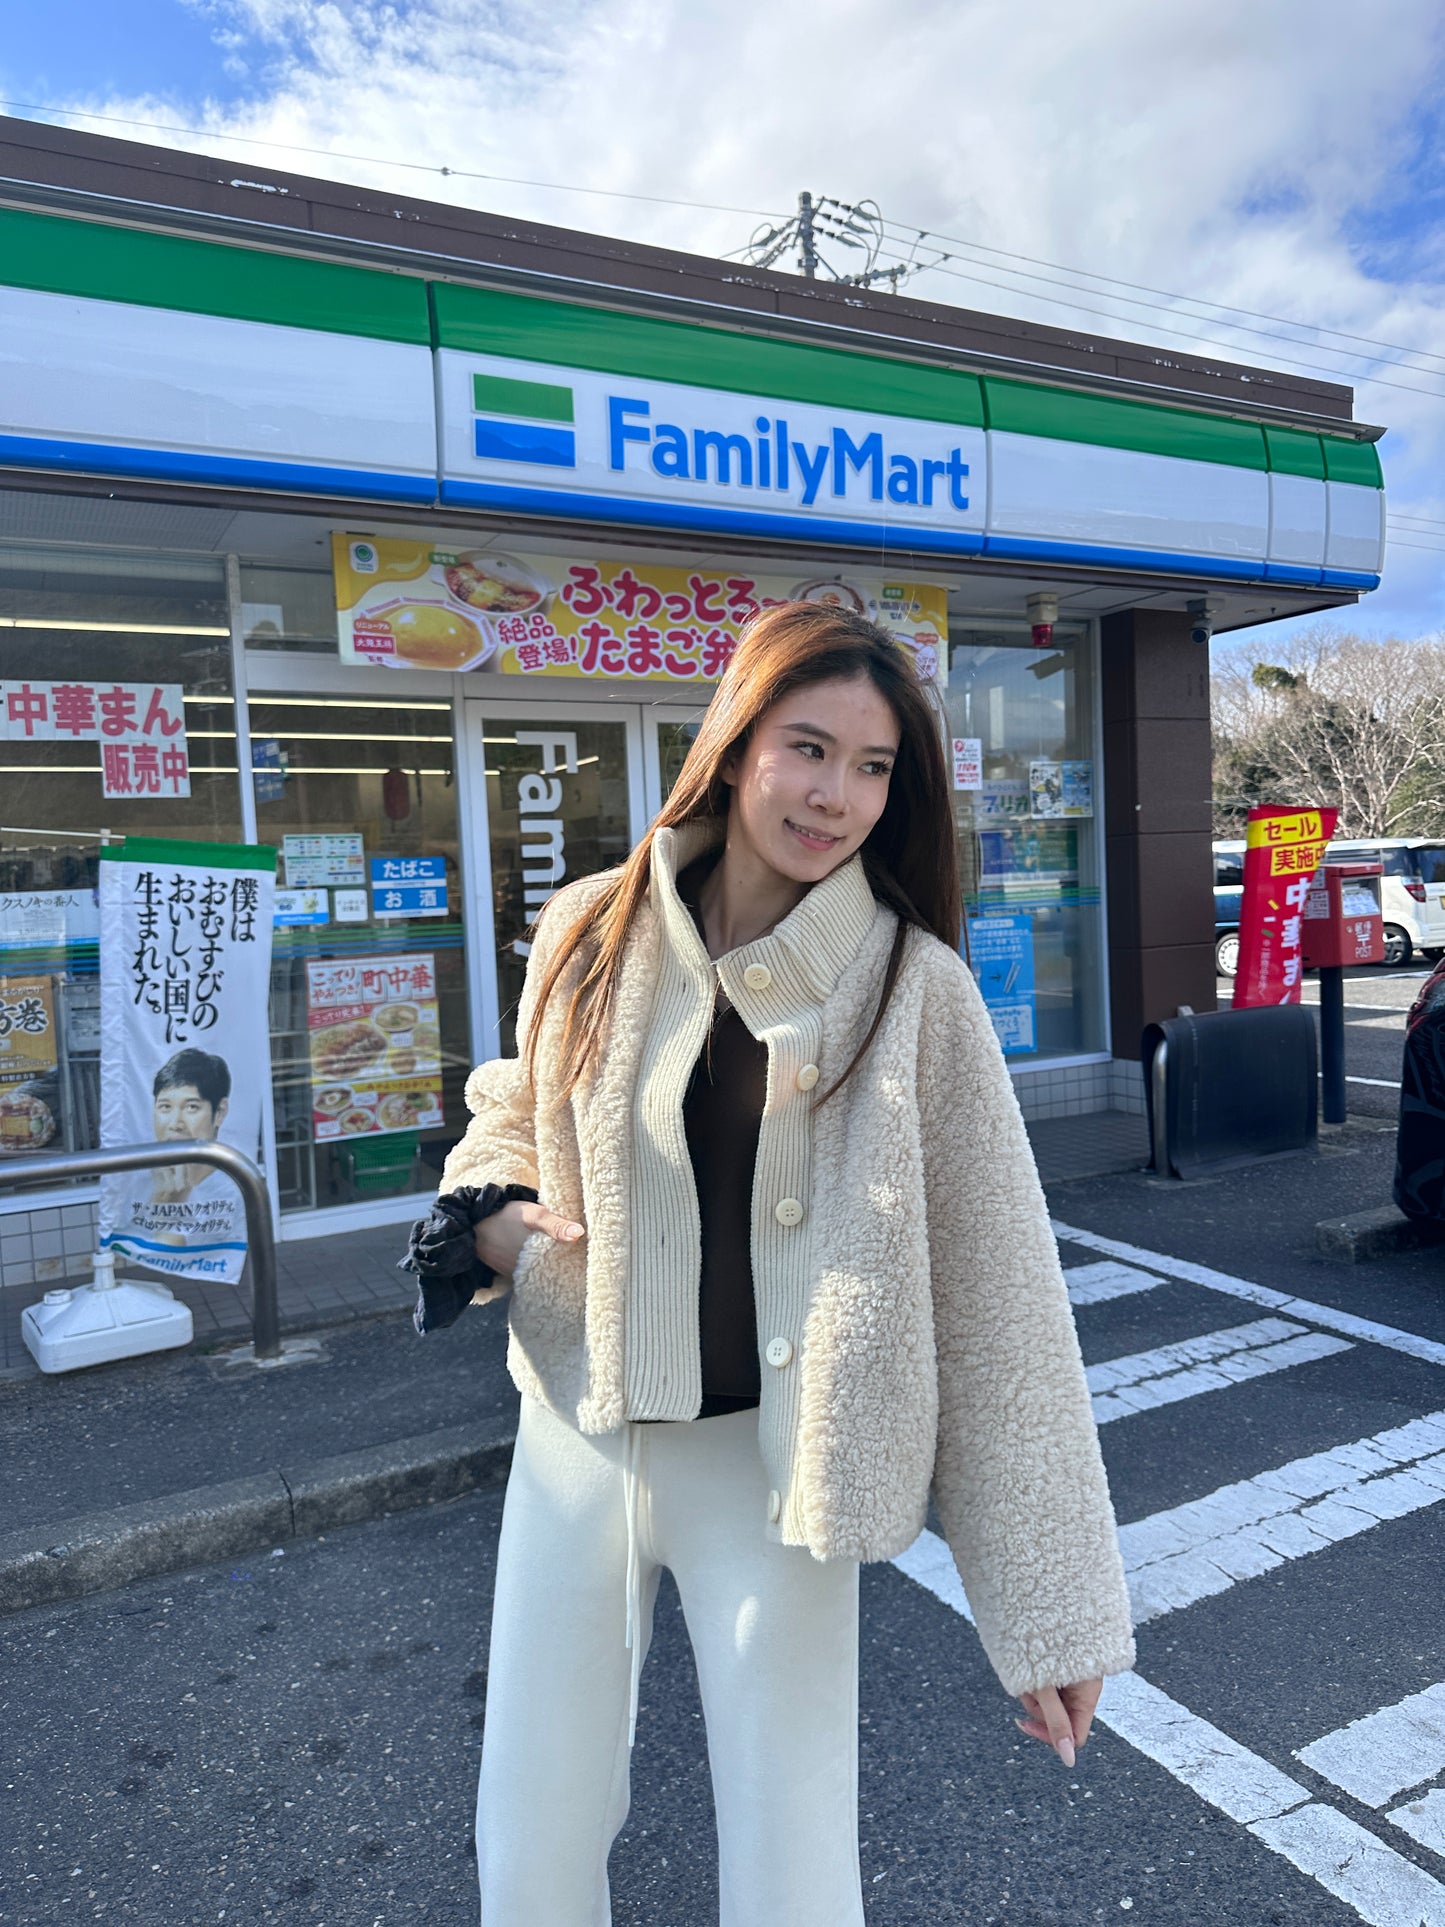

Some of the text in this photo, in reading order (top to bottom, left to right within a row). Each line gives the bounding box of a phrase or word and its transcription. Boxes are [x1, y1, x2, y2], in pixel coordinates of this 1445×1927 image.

[608, 395, 970, 511] FamilyMart
[498, 614, 555, 644] 絶品
[7, 683, 183, 737] 中華まん
[103, 742, 189, 794] 販売中
[1264, 816, 1317, 841] セール
[383, 860, 435, 879] たばこ
[2, 895, 79, 911] クスノキの番人
[230, 877, 260, 943] 僕は
[385, 889, 437, 909] お酒
[132, 871, 164, 1015] 生まれた。
[163, 872, 197, 1044] おいしい国に
[192, 875, 228, 1031] おむすびの
[1355, 945, 1373, 959] POST
[313, 967, 356, 986] こってり
[361, 963, 433, 995] 町中華
